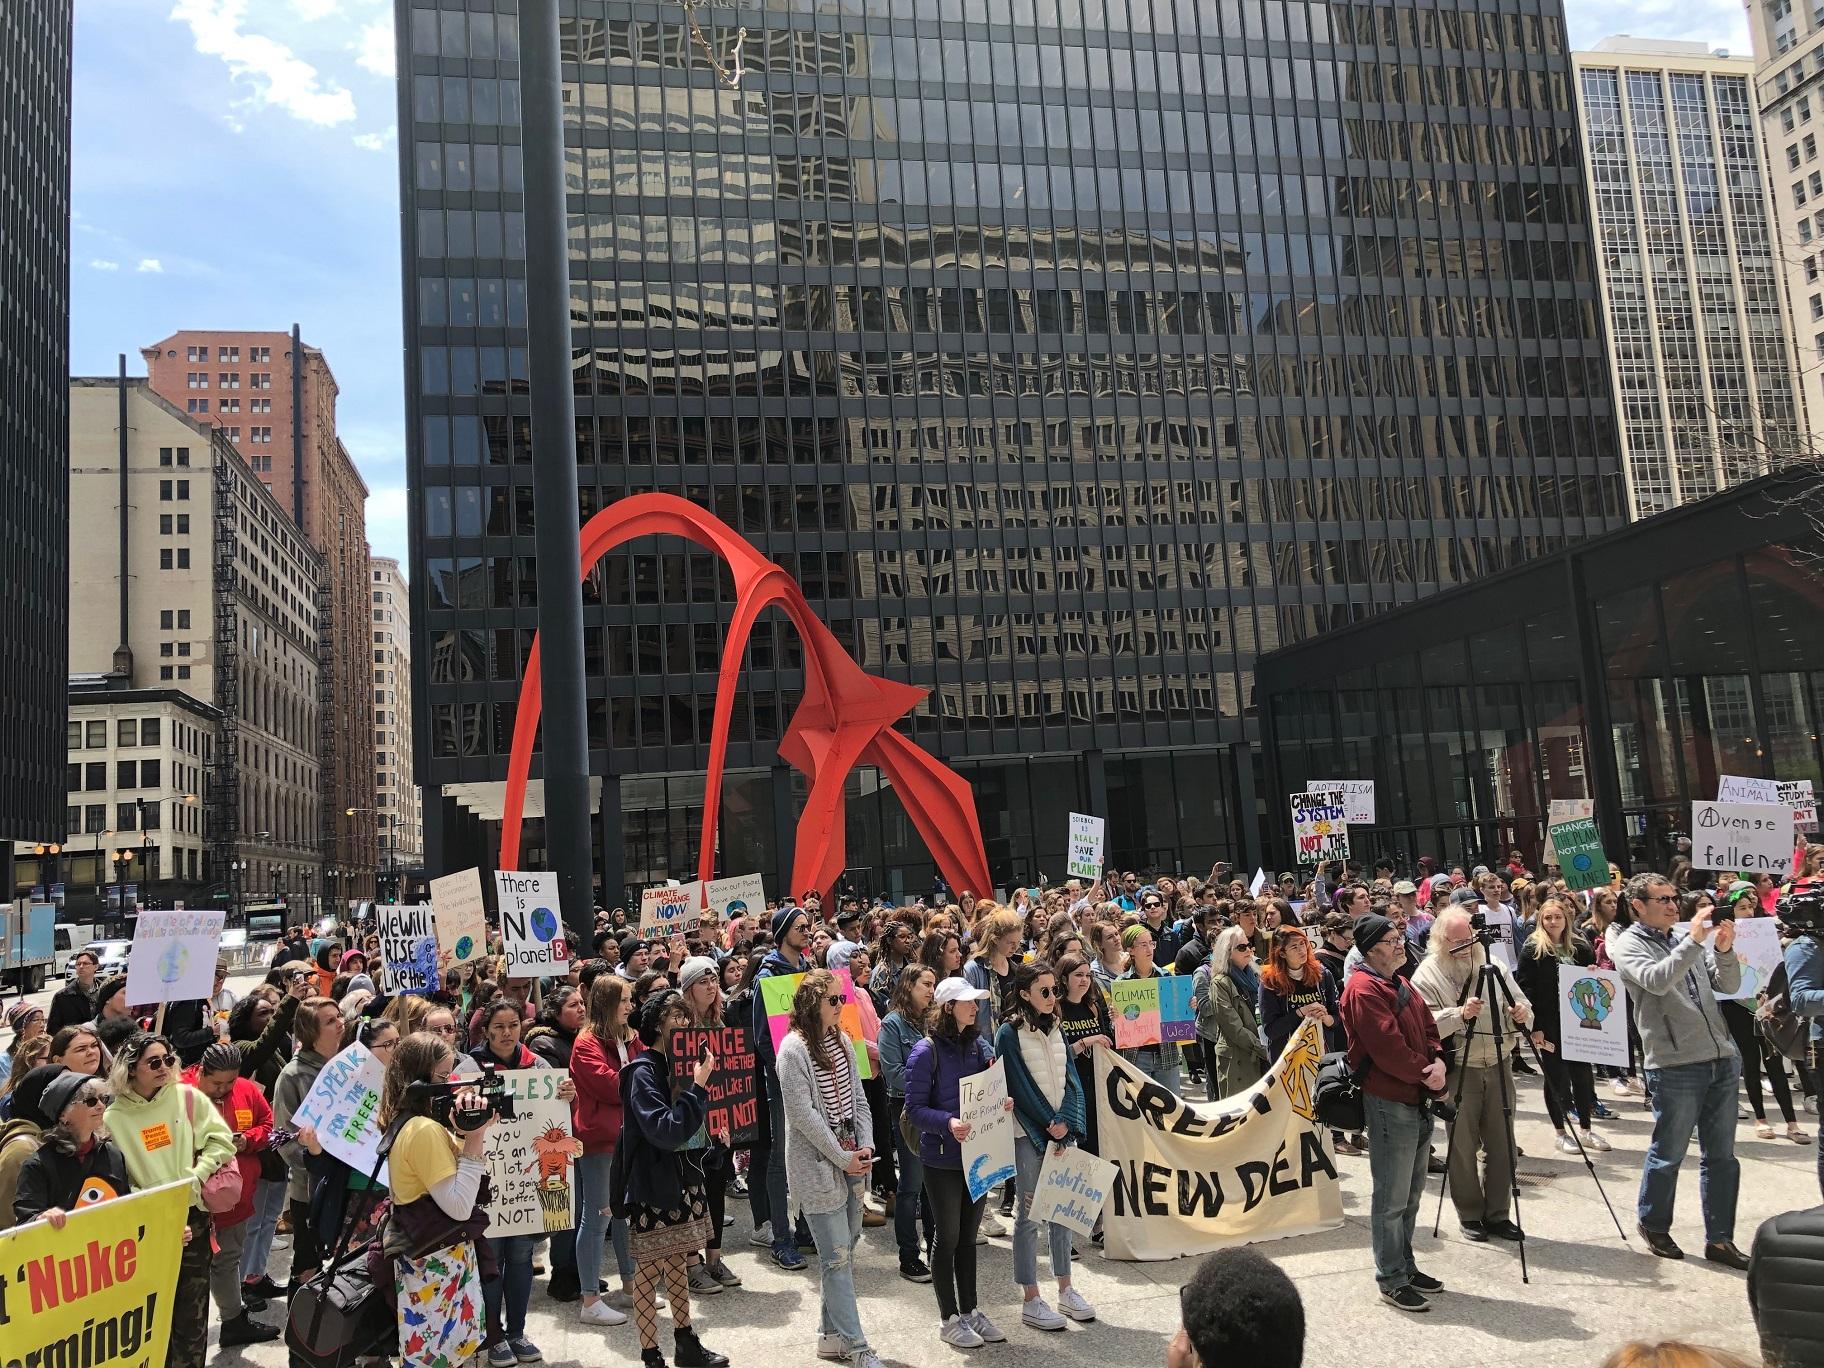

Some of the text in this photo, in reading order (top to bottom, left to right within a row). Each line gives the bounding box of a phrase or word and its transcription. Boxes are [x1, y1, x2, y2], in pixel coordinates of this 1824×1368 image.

[1720, 777, 1774, 802] ANIMAL
[1776, 782, 1798, 792] WHY
[1292, 790, 1344, 809] CHANGE THE
[1778, 791, 1804, 802] STUDY
[1072, 816, 1094, 824] SCIENCE
[1294, 806, 1346, 823] SYSTEM
[1698, 806, 1776, 831] Avenge
[1550, 820, 1595, 834] CHANGE
[1300, 833, 1346, 852] NOT THE
[1553, 834, 1572, 847] THE
[1558, 842, 1600, 856] NOT THE
[1074, 845, 1094, 856] SAVE
[1300, 846, 1349, 863] CLIMATE
[1704, 845, 1770, 869] fallen
[1070, 862, 1102, 878] PLANET
[500, 872, 540, 893] there
[1568, 869, 1607, 889] PLANET
[643, 889, 678, 900] CLIMATE
[710, 884, 728, 894] Save
[516, 896, 526, 910] is
[661, 893, 691, 906] CHANGE
[710, 895, 728, 904] Save
[656, 903, 688, 920] NOW
[384, 938, 418, 964] RISE
[506, 942, 564, 975] planet B
[1114, 988, 1156, 1003] CLIMATE
[672, 1026, 746, 1056] CHANGE
[674, 1060, 684, 1077] IS
[724, 1053, 756, 1071] WHETHER
[300, 1049, 367, 1130] I SPEAK
[704, 1076, 753, 1102] YOU LIKE IT
[961, 1082, 985, 1105] The
[326, 1080, 368, 1138] FOR THE
[344, 1090, 378, 1141] TREES
[708, 1098, 757, 1136] OR NOT
[961, 1109, 978, 1124] are
[980, 1122, 994, 1134] are
[512, 1146, 527, 1158] an
[505, 1180, 516, 1192] is
[1110, 1159, 1225, 1218] NEW
[497, 1208, 536, 1227] NOT.
